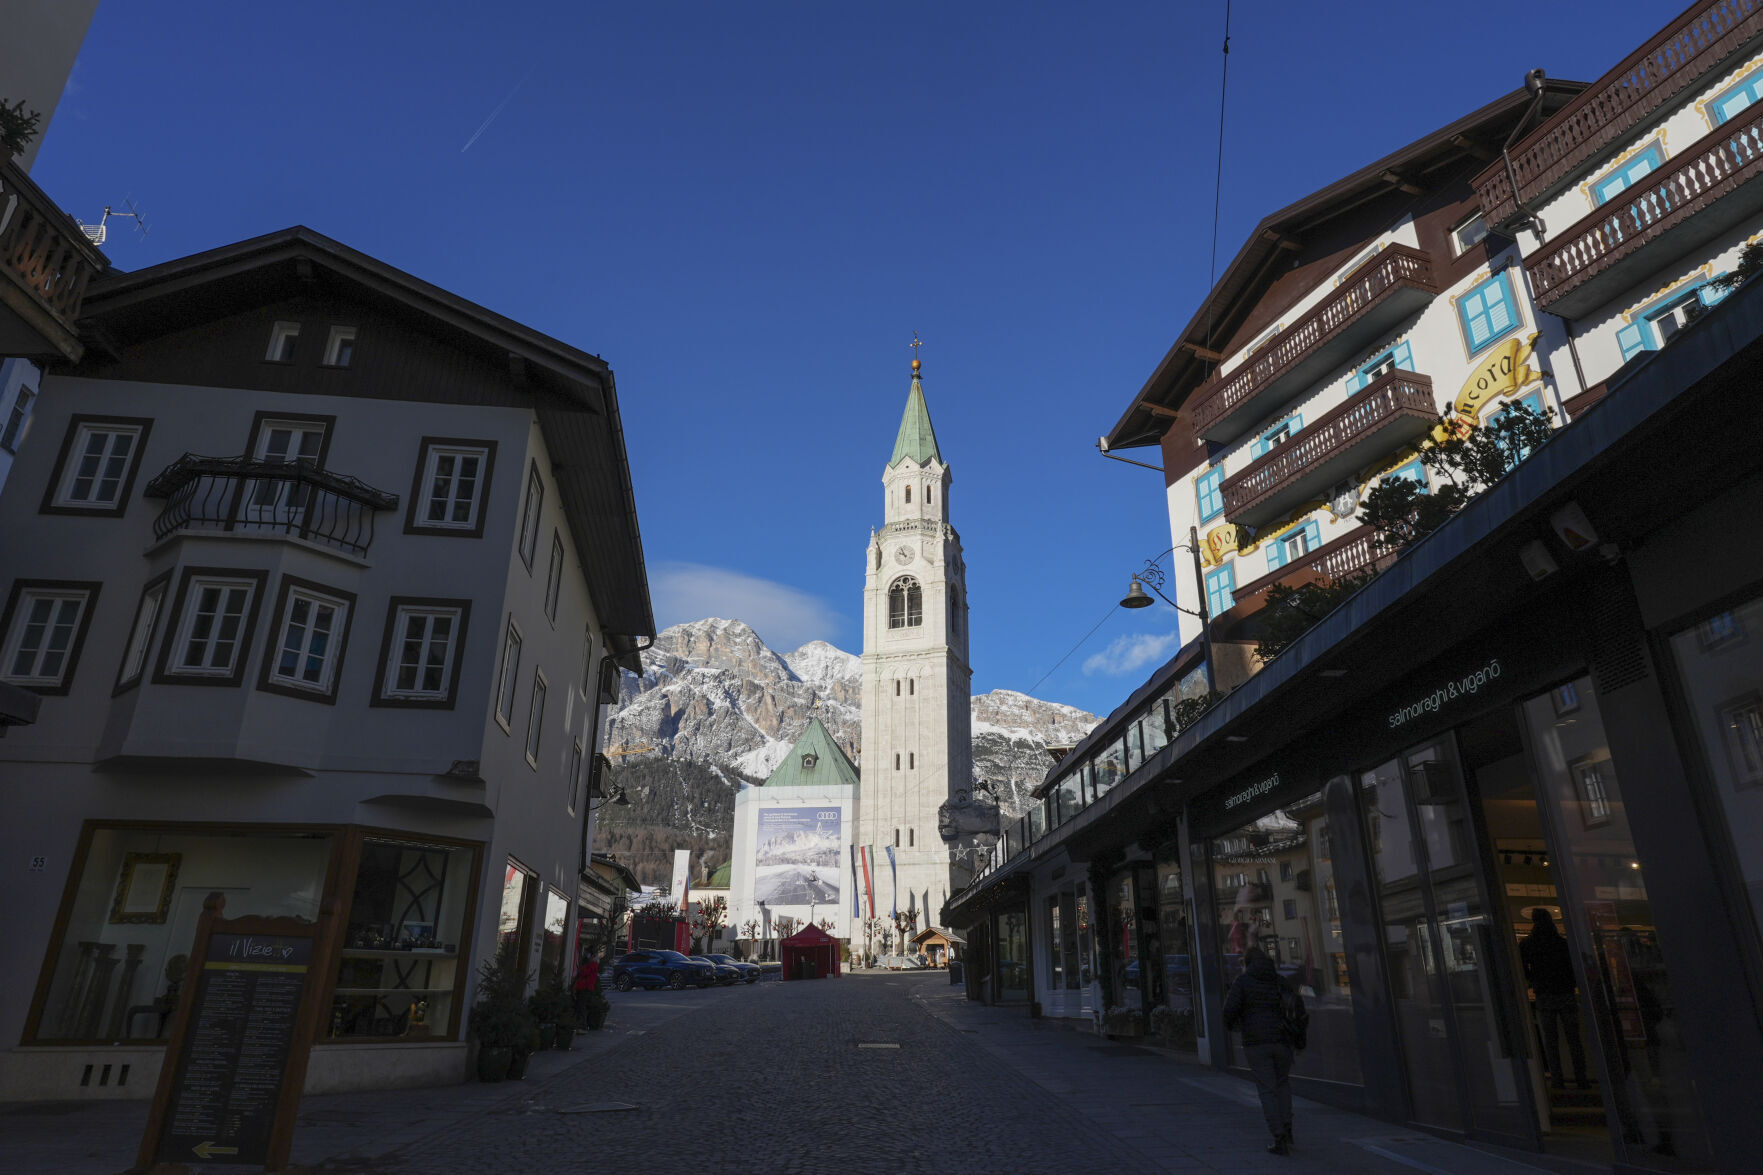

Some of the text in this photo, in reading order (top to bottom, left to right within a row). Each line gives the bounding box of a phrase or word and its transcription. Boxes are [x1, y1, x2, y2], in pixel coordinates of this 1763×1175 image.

[1388, 688, 1449, 729] salmoiraghi
[1447, 681, 1460, 699] &
[1224, 786, 1255, 810] salmoiraghi
[32, 856, 46, 868] 55
